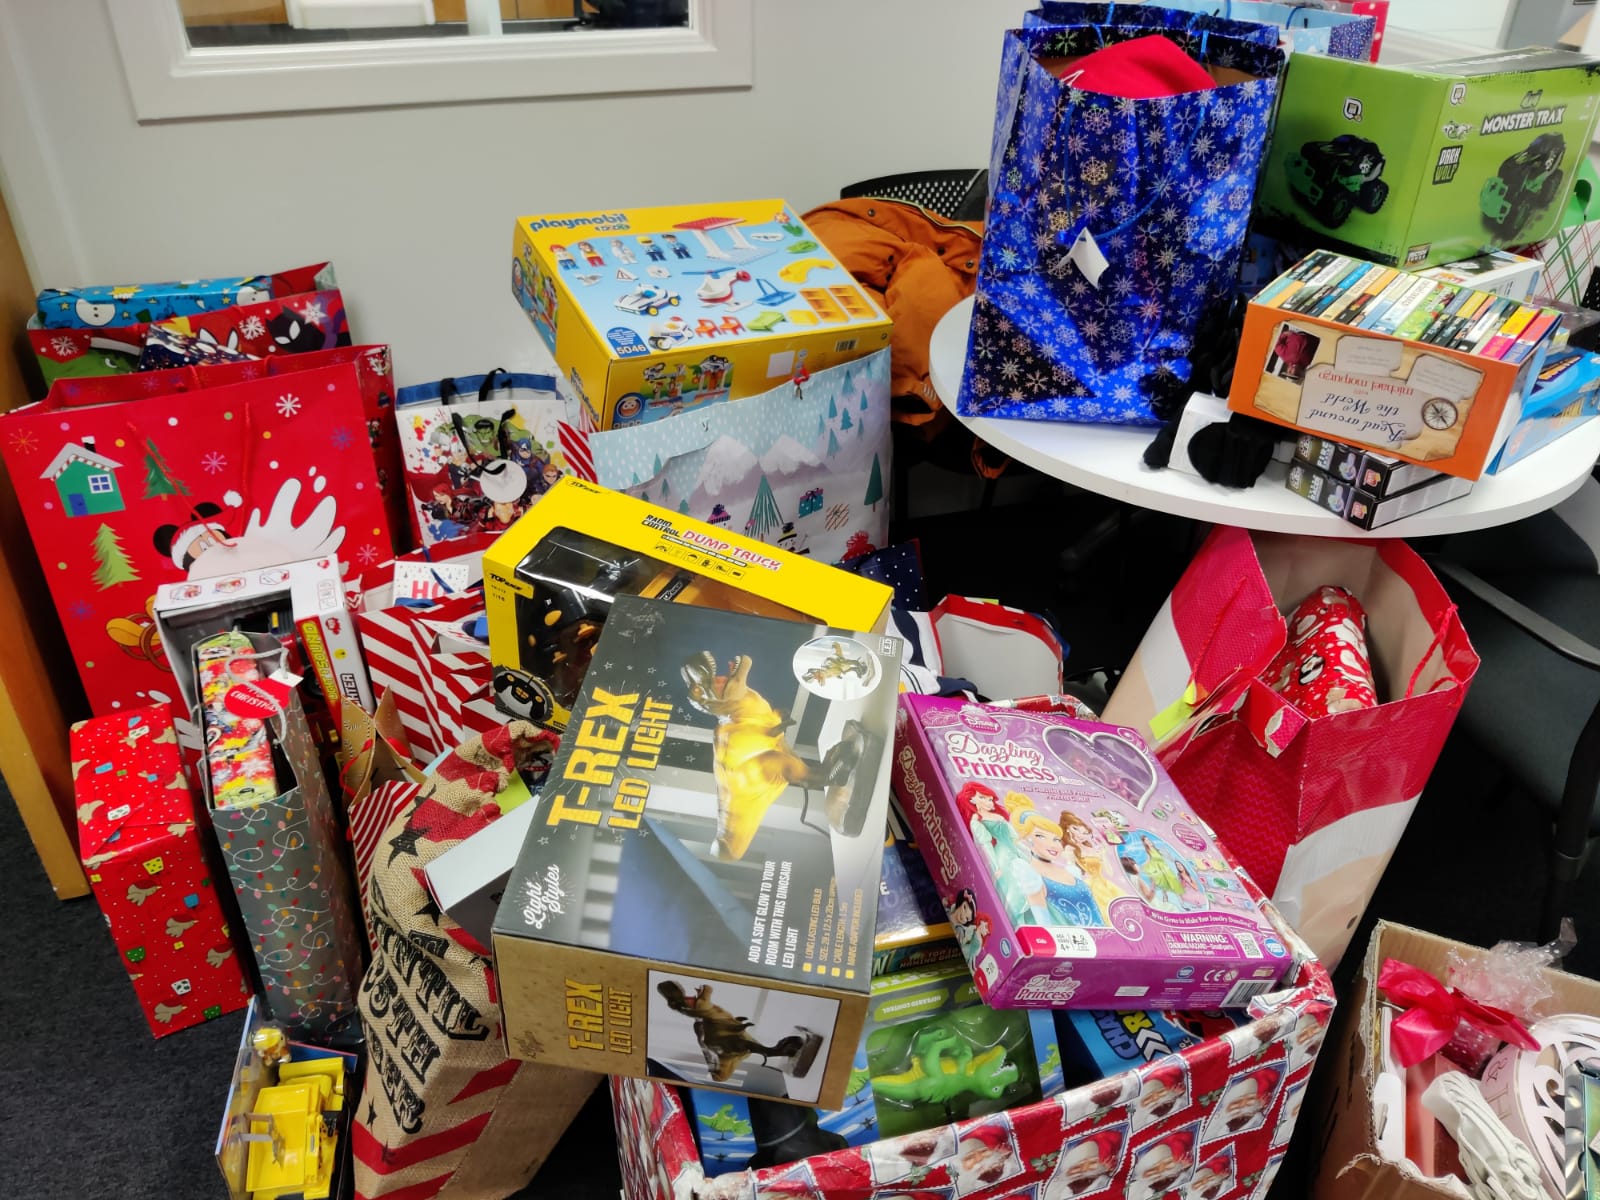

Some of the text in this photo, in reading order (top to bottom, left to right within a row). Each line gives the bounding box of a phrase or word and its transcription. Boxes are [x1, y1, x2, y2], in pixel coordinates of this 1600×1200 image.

[1481, 107, 1566, 134] MONSTER TRAX
[529, 213, 628, 232] playmobil
[616, 344, 646, 354] 5046
[1370, 380, 1414, 396] michael
[1320, 393, 1400, 419] the World
[1306, 408, 1406, 442] Read around
[641, 519, 680, 537] CONTROL
[646, 514, 672, 526] RADIO
[683, 531, 729, 550] DUMP
[733, 547, 782, 570] TRUCK
[302, 621, 330, 669] SOUND
[546, 687, 640, 826] T-REX
[946, 733, 1042, 766] Dazzling
[608, 697, 673, 829] LED LIGHT
[952, 757, 1055, 781] Princess
[900, 747, 958, 878] Dazzling Princess
[762, 860, 776, 881] YOUR
[541, 863, 565, 914] Styles
[760, 882, 772, 893] TO
[523, 881, 546, 930] Light
[757, 893, 770, 916] GLOW
[765, 861, 792, 966] ROOM WITH THIS DINOSAUR
[752, 916, 766, 938] SOFT
[1180, 932, 1228, 944] WARNING:
[748, 945, 760, 963] ADD
[782, 926, 799, 968] LED LIGHT
[1016, 988, 1073, 1000] Princess
[565, 976, 605, 1051] T-REX
[608, 986, 632, 1054] LED LIGHT
